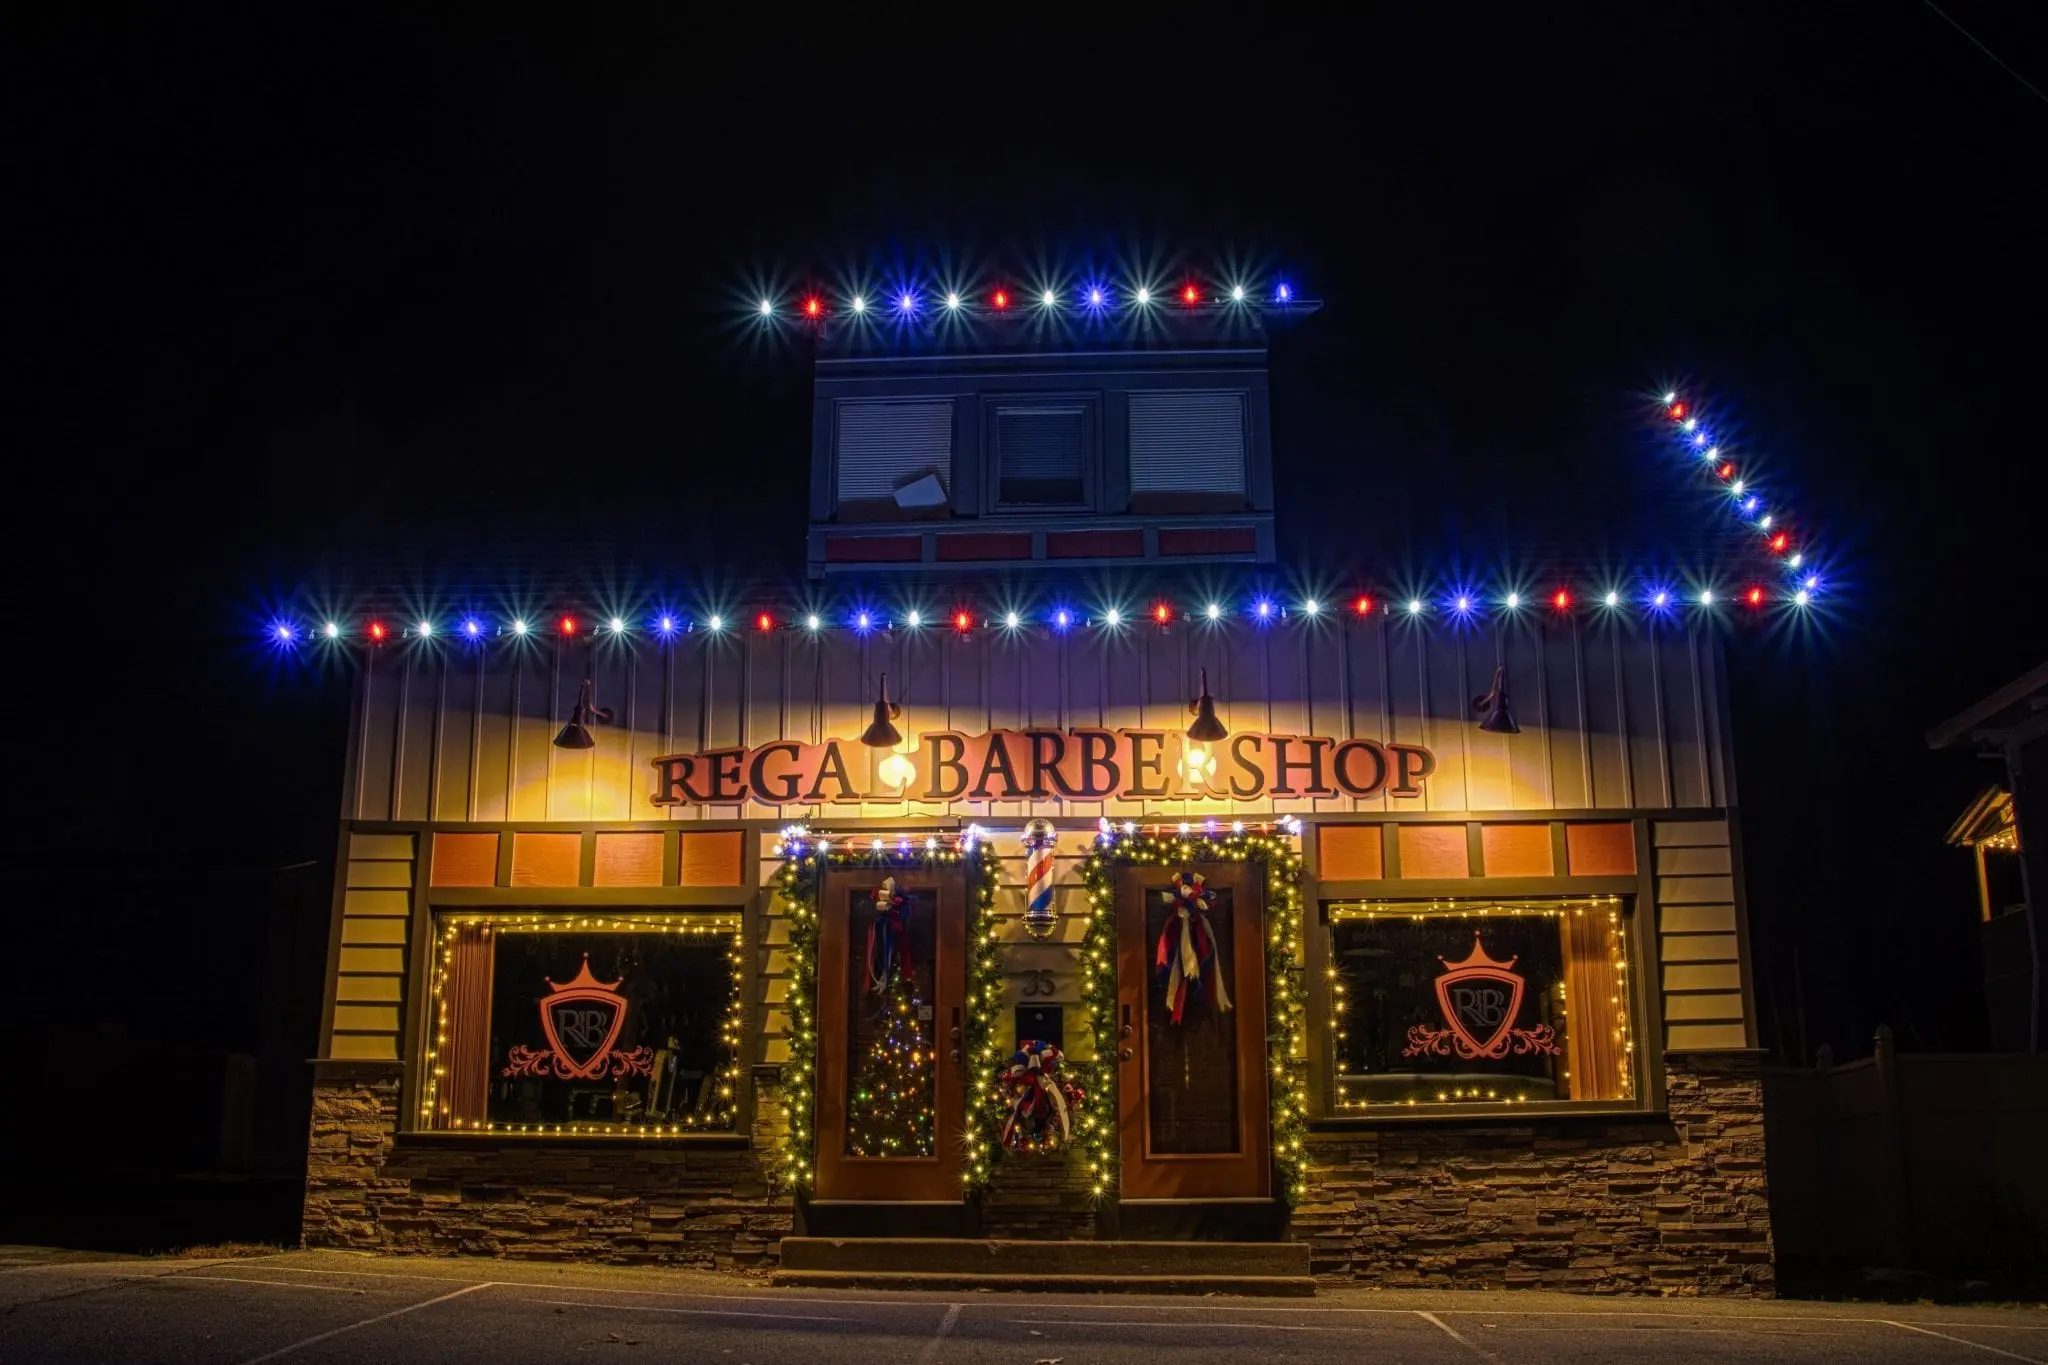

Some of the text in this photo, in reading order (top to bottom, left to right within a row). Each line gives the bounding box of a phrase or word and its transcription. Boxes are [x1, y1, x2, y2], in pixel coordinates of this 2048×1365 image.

[656, 731, 1436, 801] REGAL BARBERSHOP
[1022, 969, 1056, 996] 35
